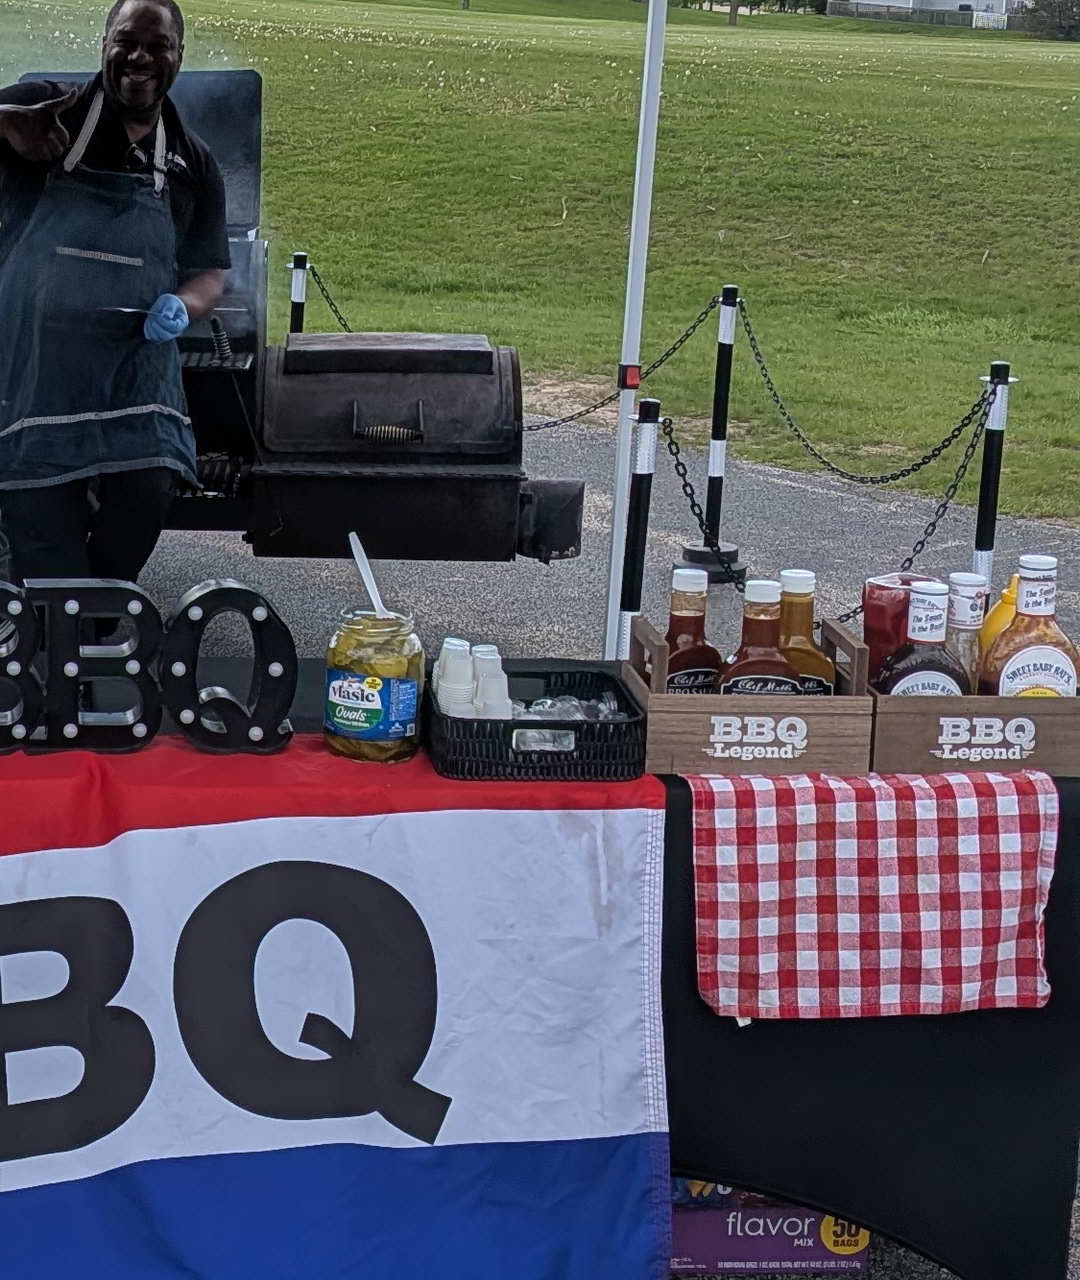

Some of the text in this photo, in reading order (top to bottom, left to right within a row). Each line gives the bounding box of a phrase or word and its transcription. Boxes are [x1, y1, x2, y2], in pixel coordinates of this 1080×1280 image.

[1006, 663, 1031, 683] SWEET
[1033, 663, 1054, 672] BABY
[1054, 666, 1073, 684] RAY'S
[738, 679, 763, 693] Chef
[921, 682, 941, 691] BABY
[336, 706, 367, 722] Ovals
[710, 715, 808, 749] BBQ
[938, 717, 1036, 750] BBQ
[714, 744, 793, 760] Legend
[942, 745, 1021, 761] Legend
[726, 1211, 815, 1236] flavor
[793, 1238, 814, 1247] MIX
[832, 1238, 859, 1247] BAGS
